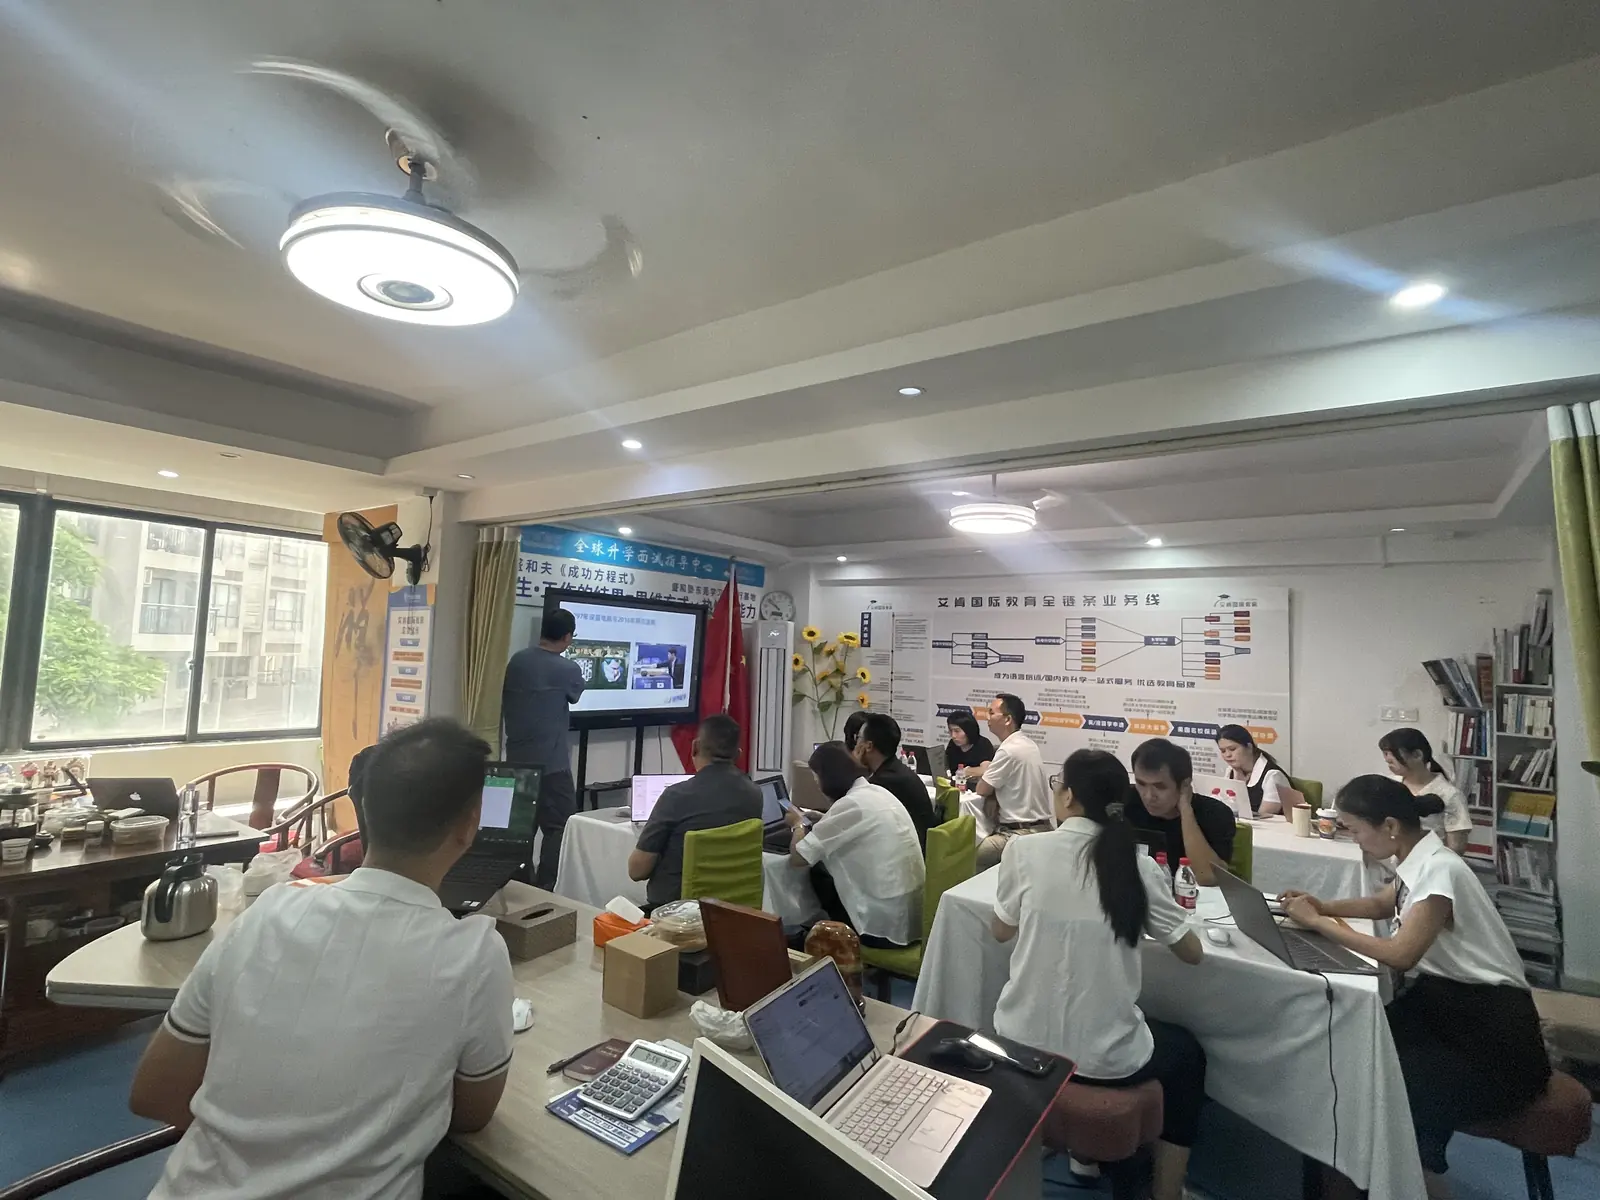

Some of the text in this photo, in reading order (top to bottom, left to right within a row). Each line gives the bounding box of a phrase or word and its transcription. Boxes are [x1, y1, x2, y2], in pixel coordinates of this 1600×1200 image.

[574, 538, 713, 572] 全球升学面试指导中心
[937, 593, 1160, 608] 艾肯国际教育全链条业务线
